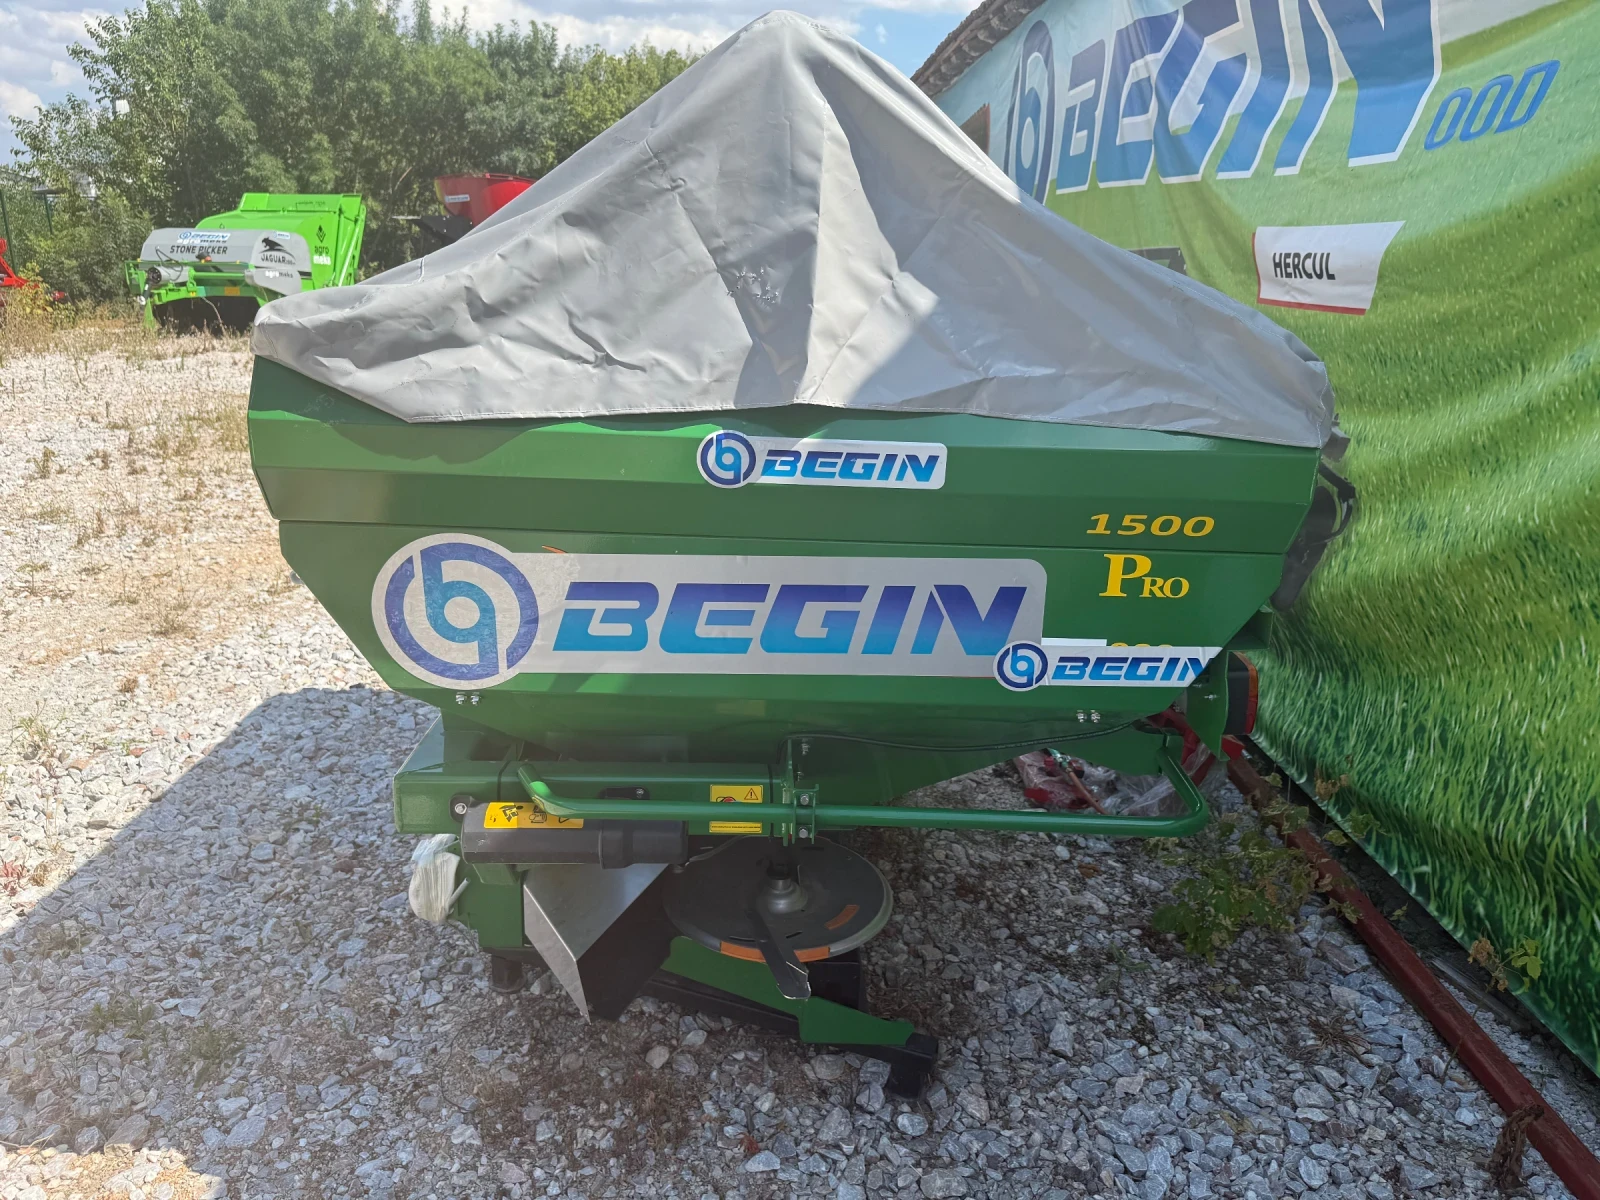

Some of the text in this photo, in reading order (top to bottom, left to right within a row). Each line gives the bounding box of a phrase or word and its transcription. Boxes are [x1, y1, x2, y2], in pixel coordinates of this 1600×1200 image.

[170, 245, 228, 255] STONE PICKER
[261, 253, 286, 264] JAGUAR
[314, 246, 330, 256] agro
[313, 255, 331, 265] meka
[1272, 252, 1336, 280] HERCUL
[761, 449, 940, 483] BEGIN
[1086, 513, 1215, 537] 1500
[552, 581, 1027, 656] BEGIN
